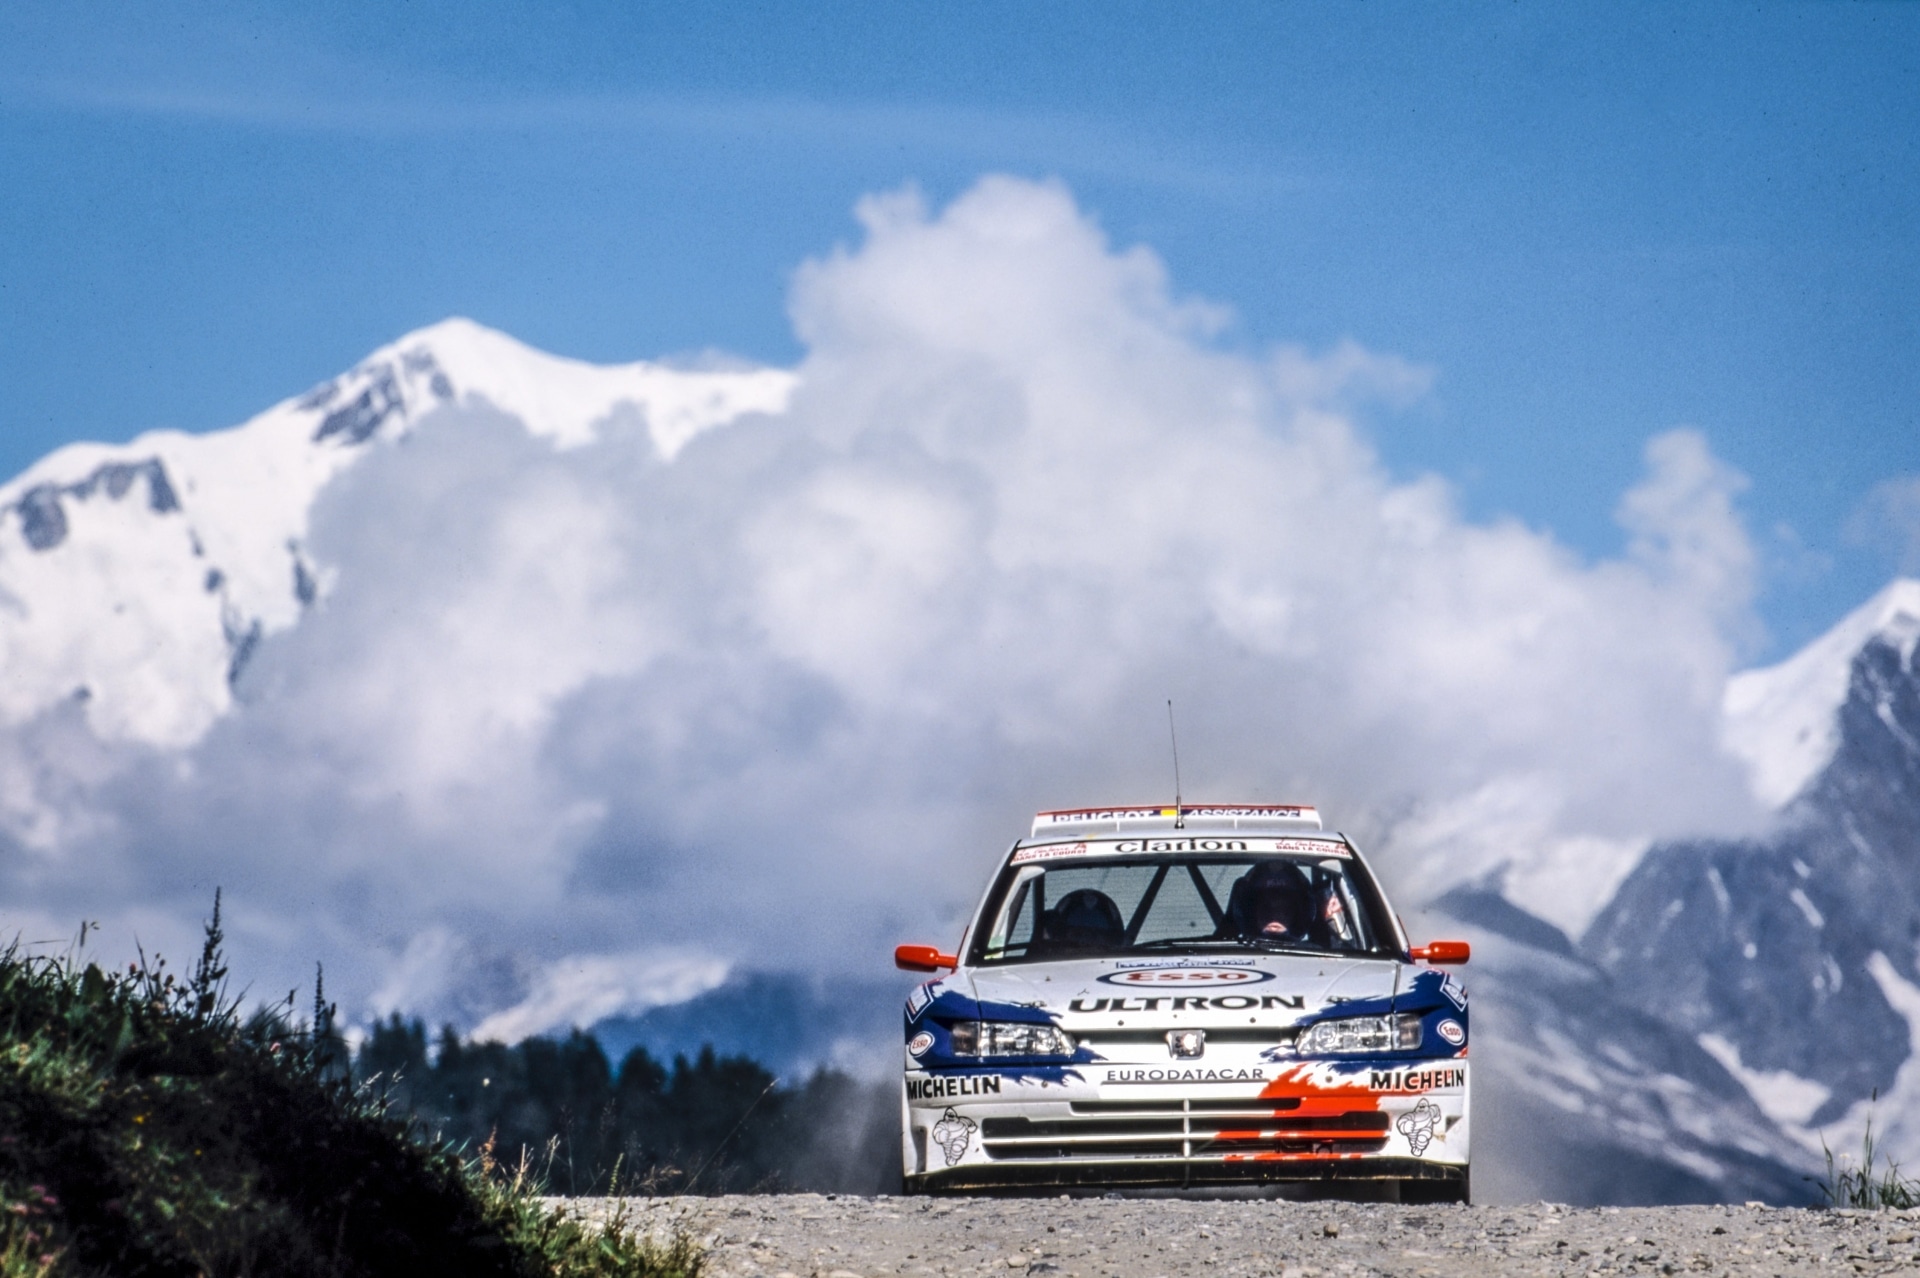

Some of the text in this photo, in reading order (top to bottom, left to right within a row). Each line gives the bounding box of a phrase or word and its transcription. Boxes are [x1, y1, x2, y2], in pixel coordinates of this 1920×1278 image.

[1055, 810, 1154, 821] PEUGEOT
[1068, 995, 1306, 1013] ULTRON
[1107, 1068, 1264, 1081] EURODATACAR
[1370, 1069, 1465, 1090] MICHELIN
[907, 1076, 1000, 1100] MICHELIN
